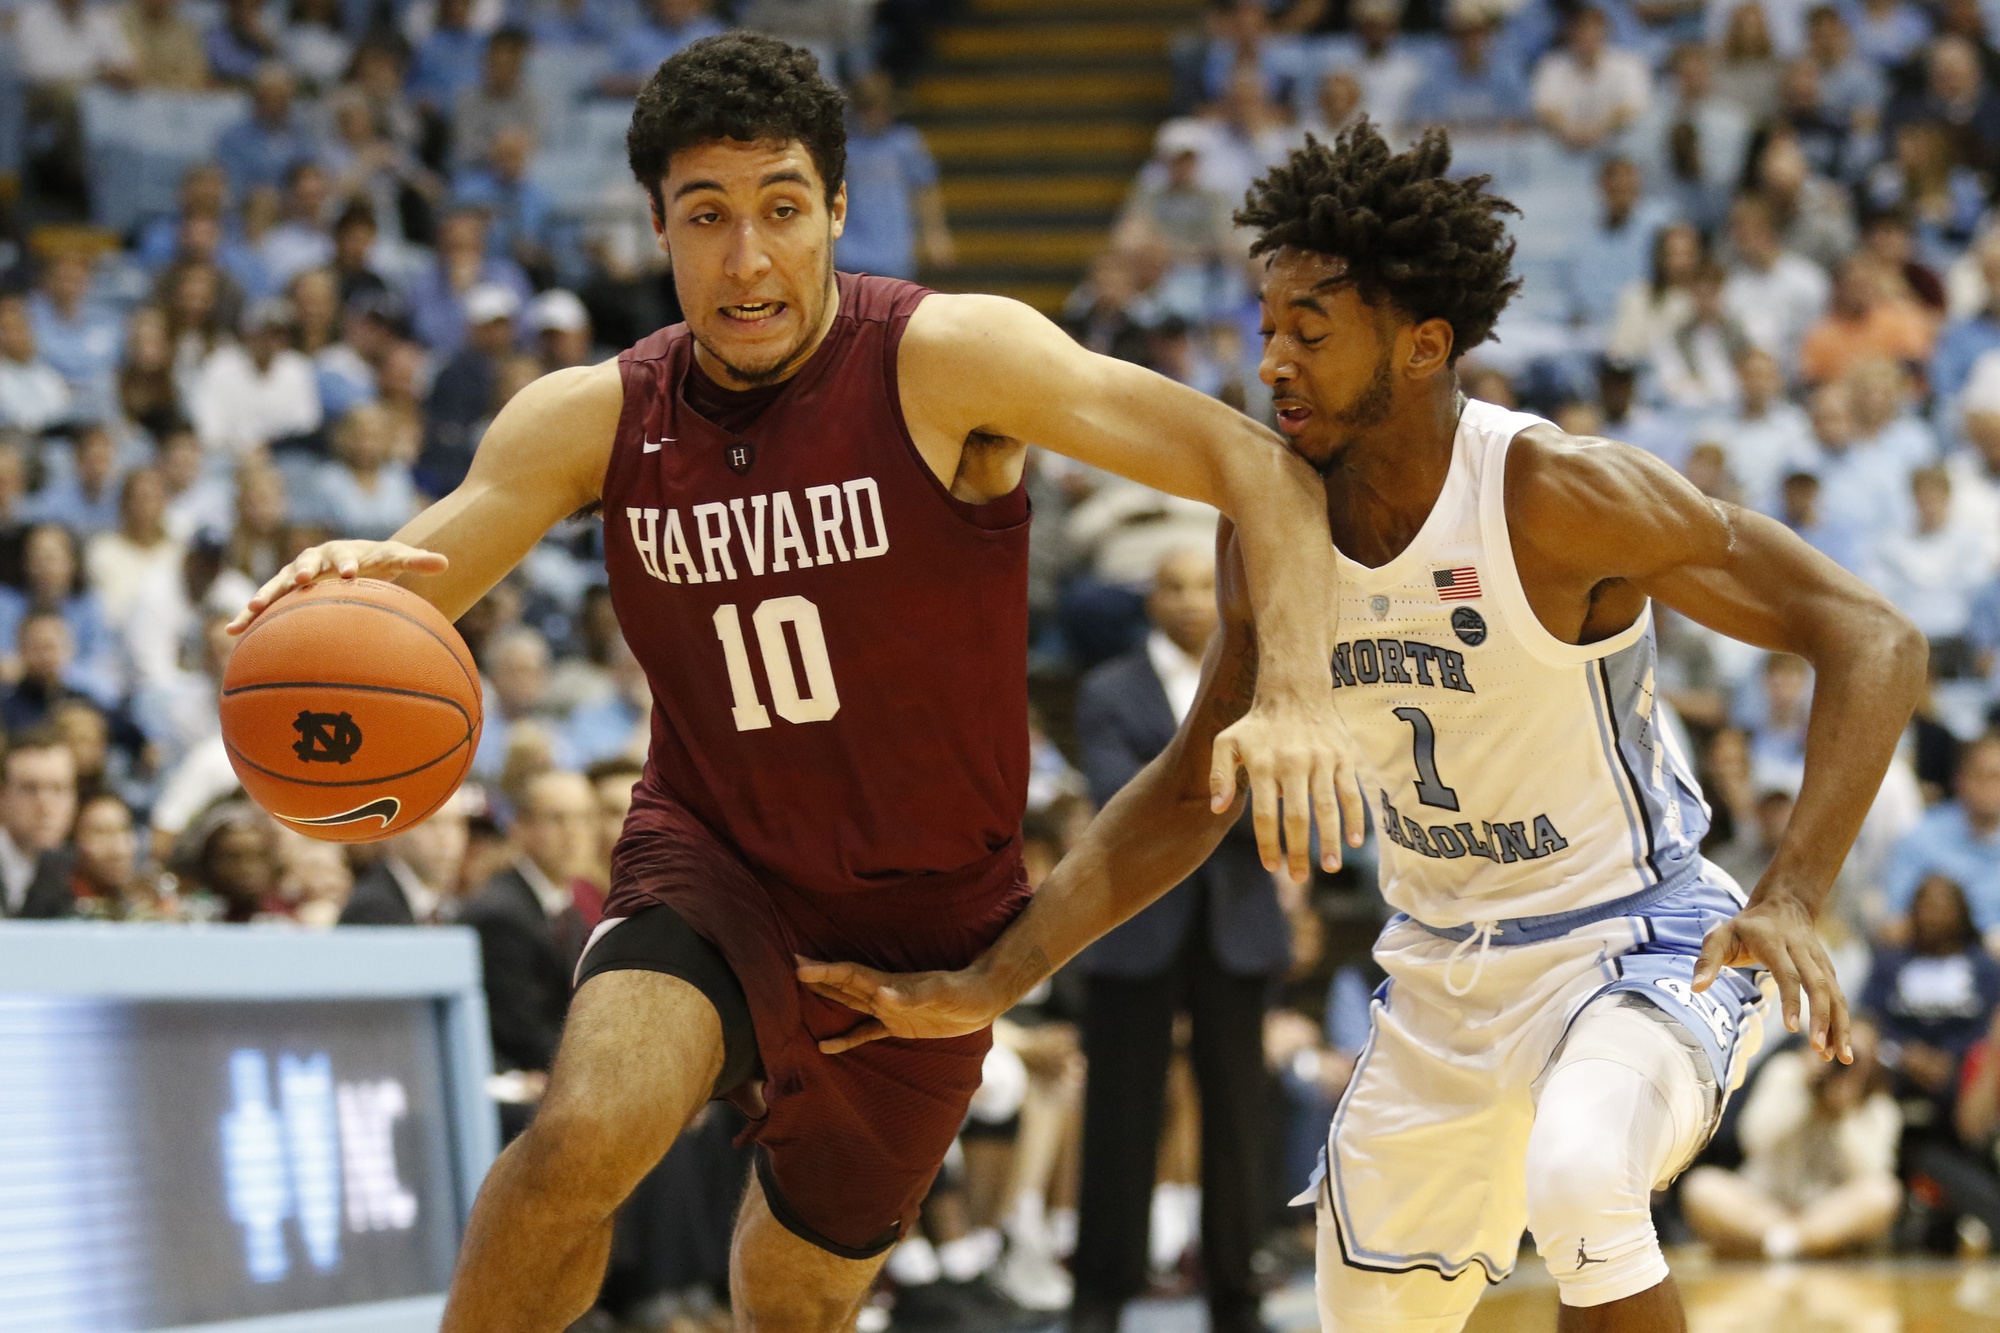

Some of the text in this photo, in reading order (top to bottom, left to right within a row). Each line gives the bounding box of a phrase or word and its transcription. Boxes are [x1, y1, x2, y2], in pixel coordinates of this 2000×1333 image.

[731, 448, 747, 466] H
[626, 477, 889, 584] HARVARD
[712, 595, 841, 732] 10
[1457, 619, 1482, 629] ACC
[1331, 639, 1476, 694] NORTH
[1392, 707, 1460, 812] 1
